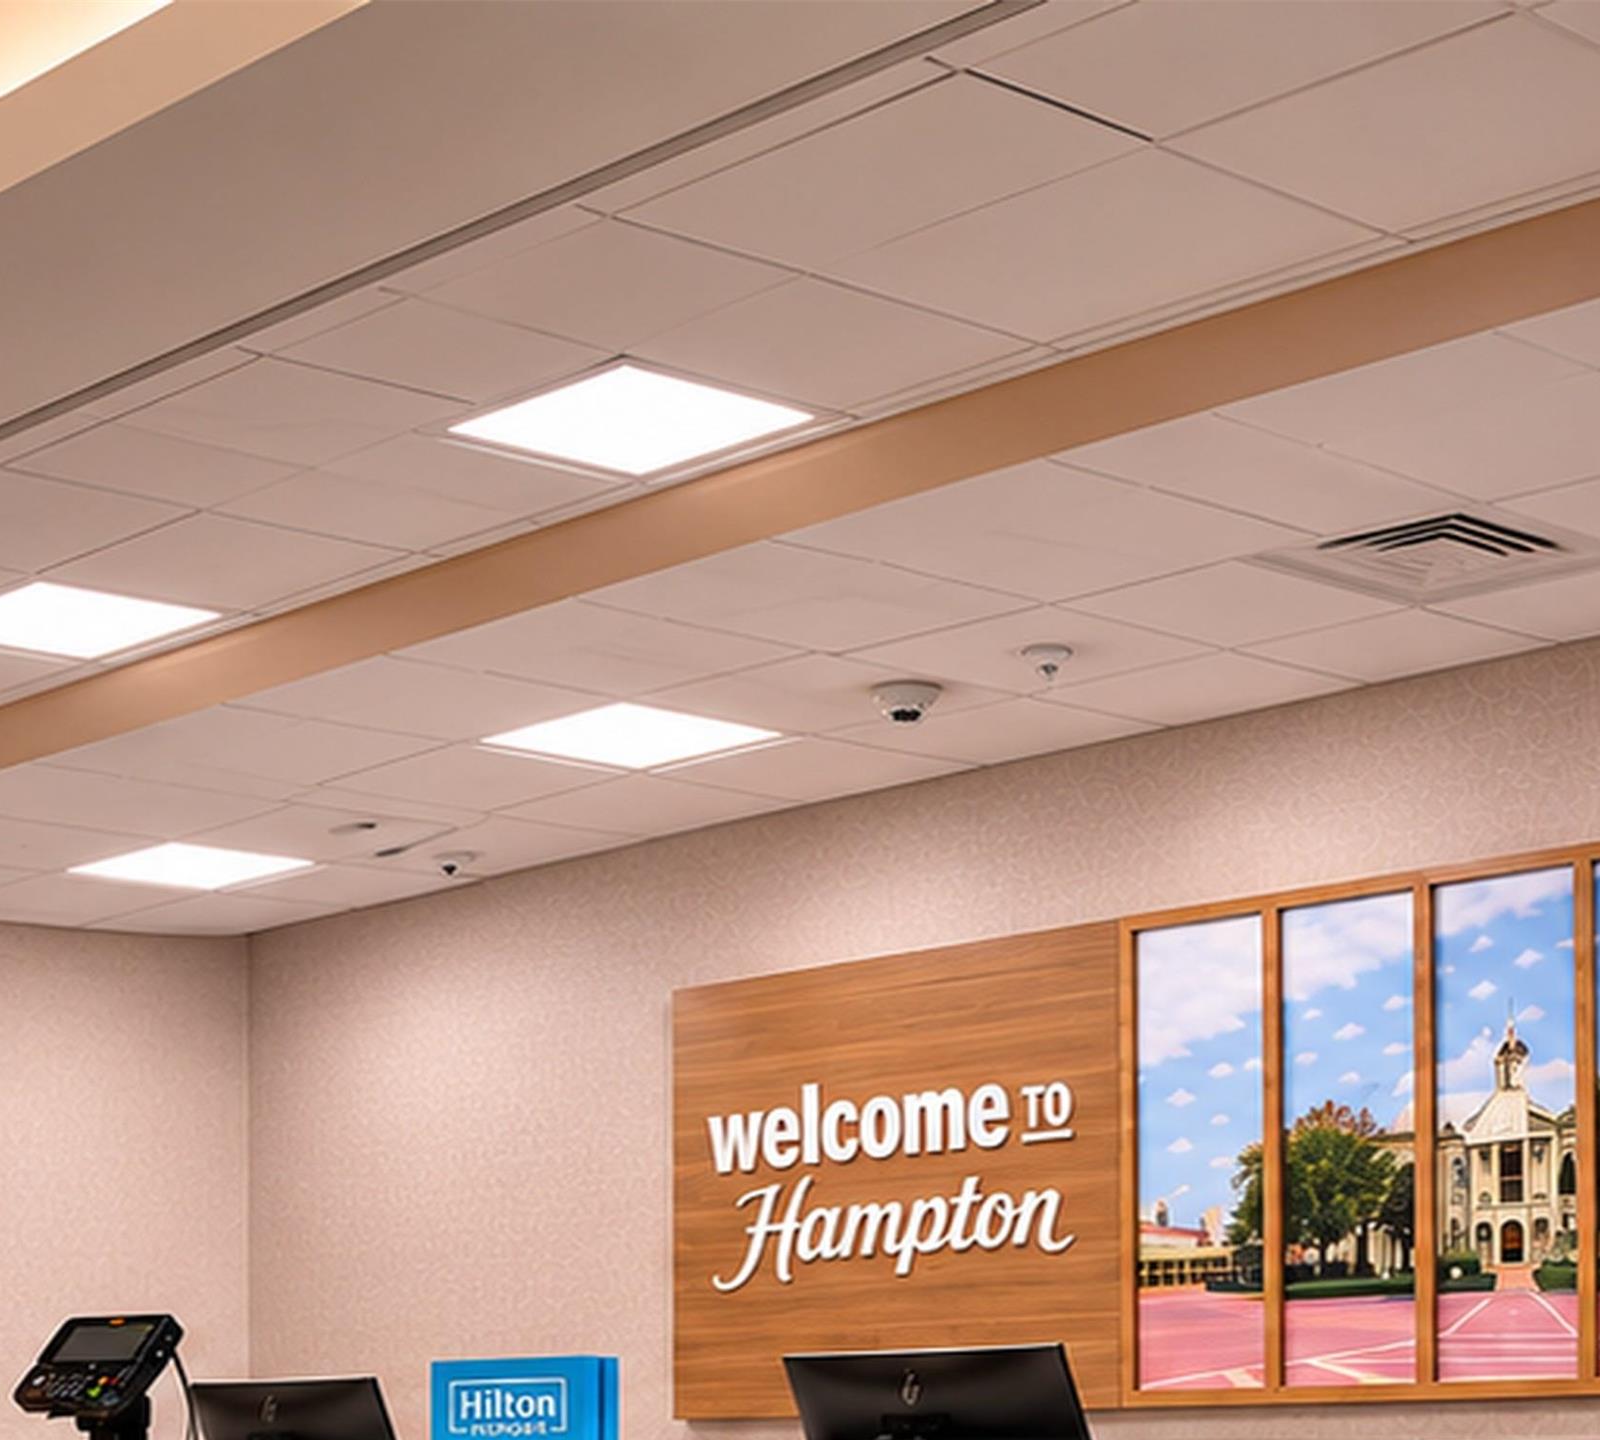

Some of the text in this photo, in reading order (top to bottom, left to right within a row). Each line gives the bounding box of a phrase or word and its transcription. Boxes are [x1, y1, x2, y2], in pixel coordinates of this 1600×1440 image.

[707, 1080, 1074, 1174] welcome TO
[711, 1174, 1076, 1293] Hampton
[459, 1387, 557, 1420] Hilton
